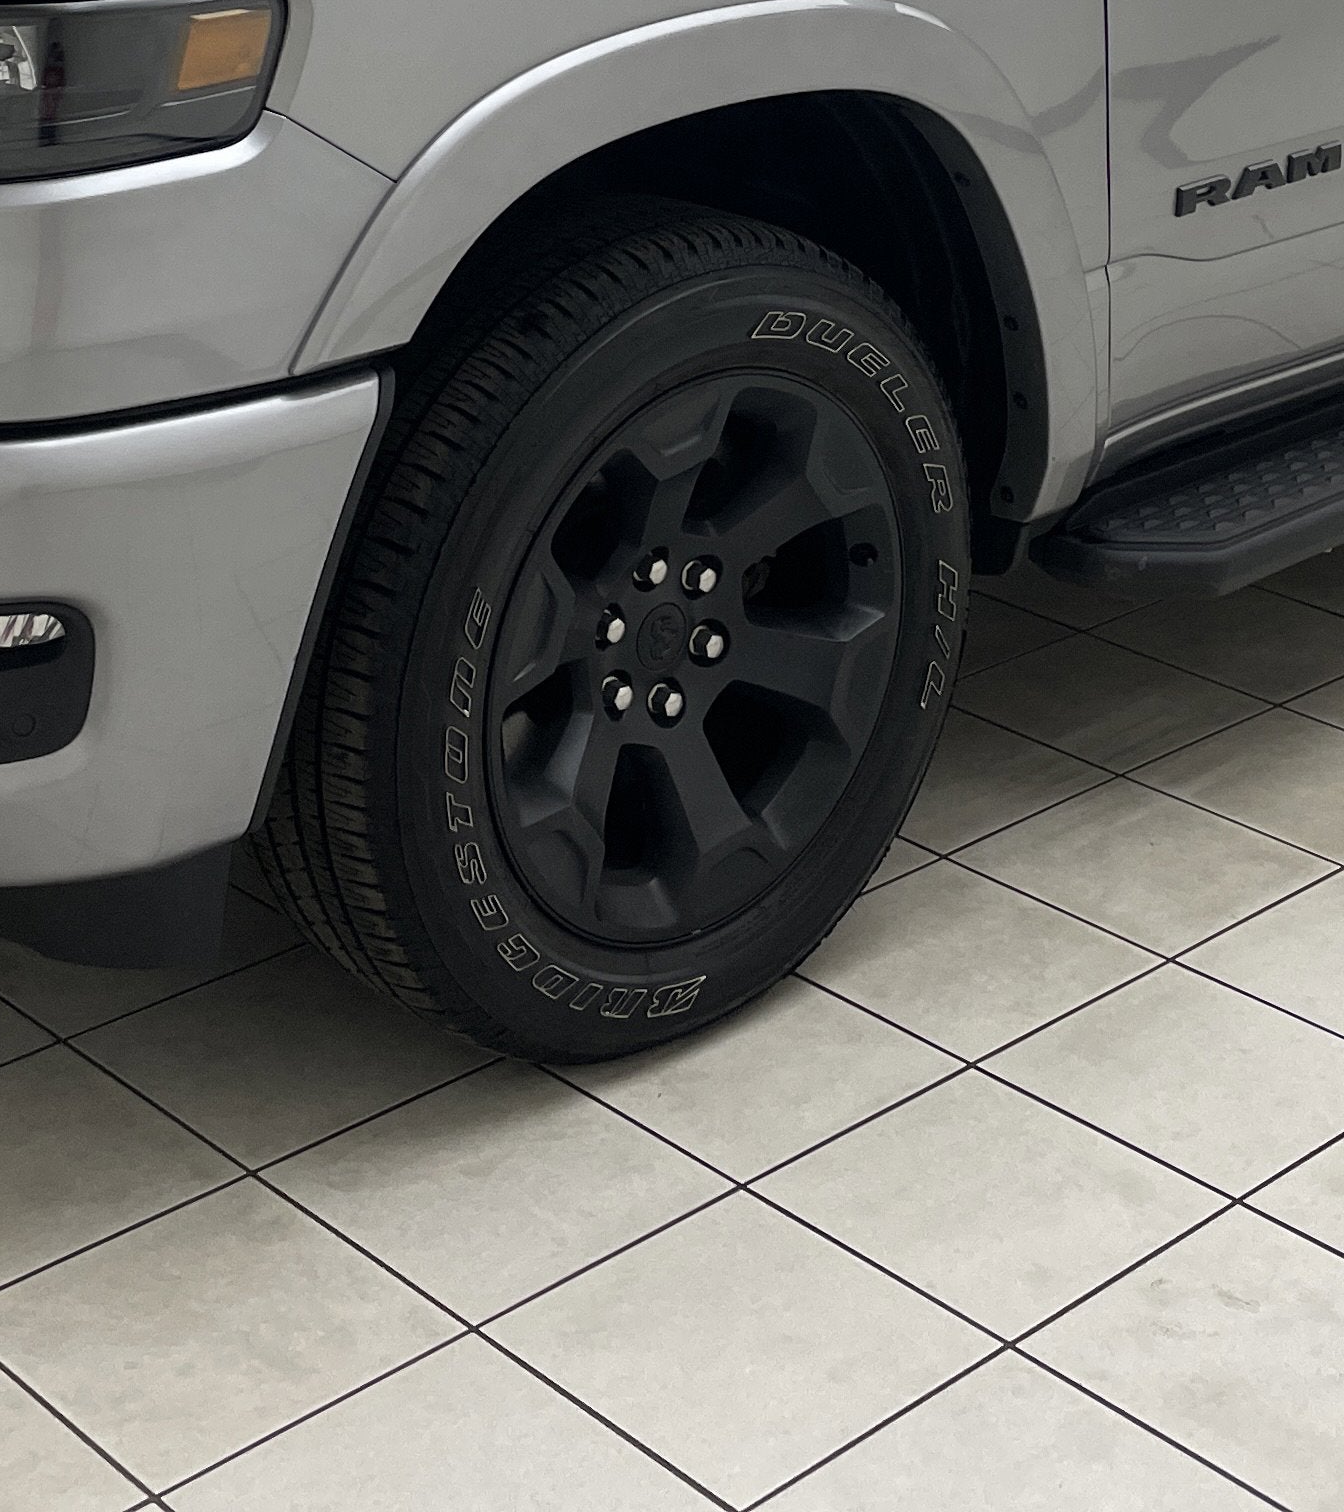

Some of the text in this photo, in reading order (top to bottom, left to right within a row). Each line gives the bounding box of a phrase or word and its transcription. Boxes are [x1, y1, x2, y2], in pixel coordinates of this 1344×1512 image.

[1173, 140, 1343, 218] RAM
[752, 311, 954, 515] DUELER
[445, 587, 707, 1019] BRIDGESTONE
